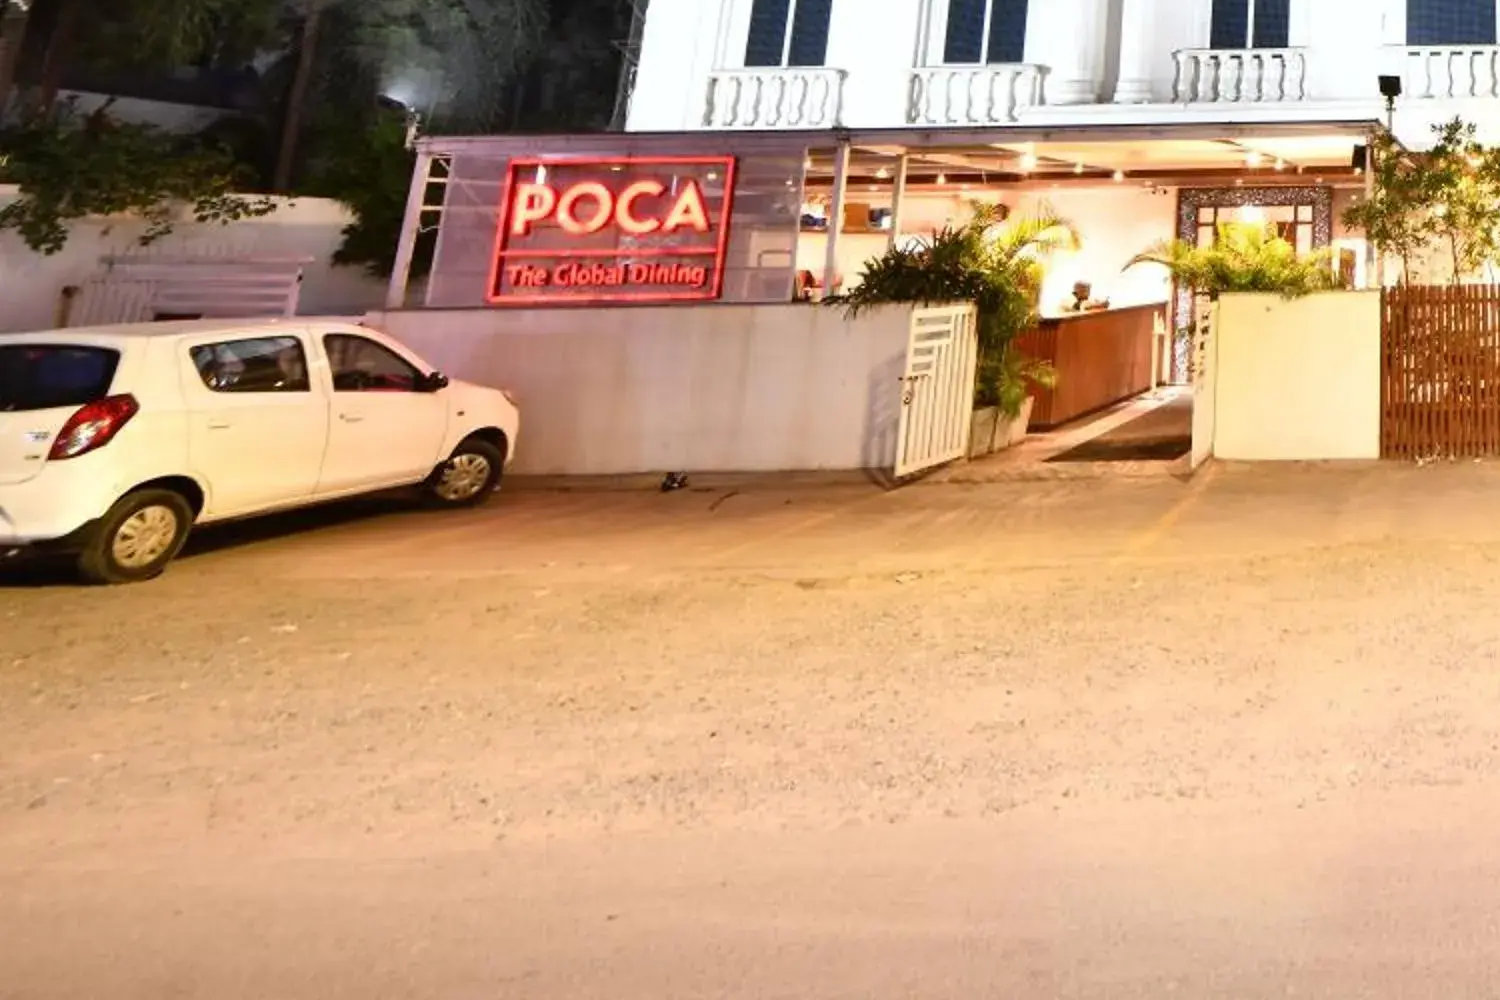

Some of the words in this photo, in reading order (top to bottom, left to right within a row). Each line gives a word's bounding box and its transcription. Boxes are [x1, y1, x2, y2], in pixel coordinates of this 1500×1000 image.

[510, 179, 712, 236] POCA
[506, 265, 549, 287] The
[553, 263, 627, 286] Global
[631, 263, 707, 288] Dining
